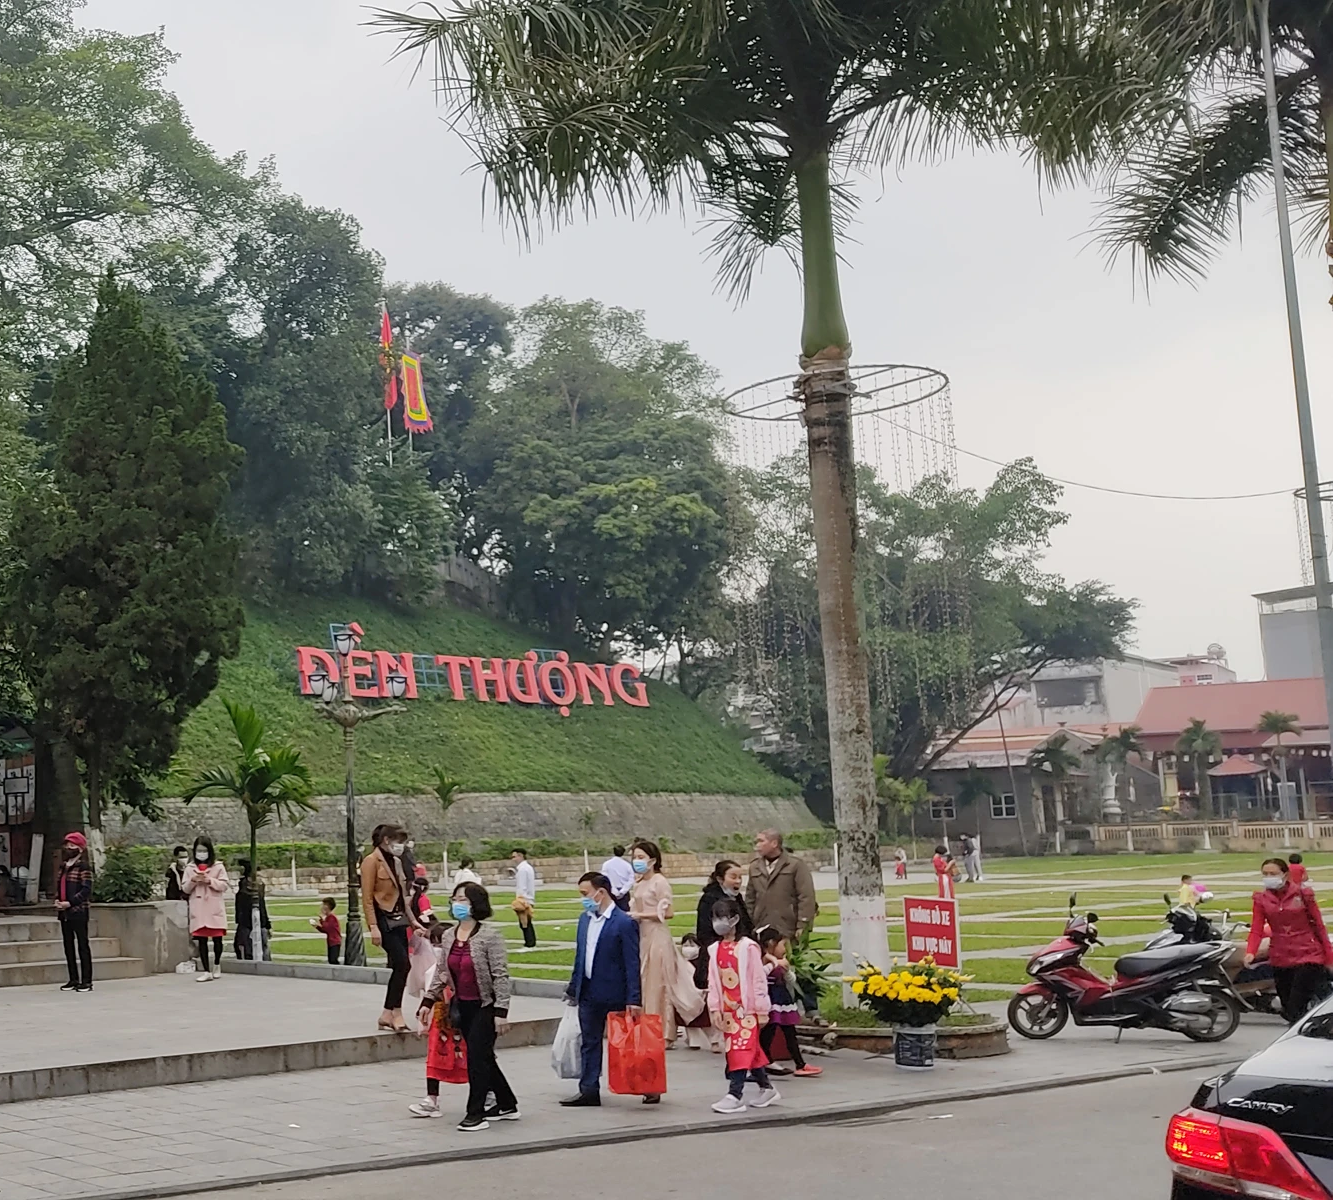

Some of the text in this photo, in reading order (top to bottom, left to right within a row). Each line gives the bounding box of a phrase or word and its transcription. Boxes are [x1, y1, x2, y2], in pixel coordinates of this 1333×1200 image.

[434, 650, 651, 717] THƯỢNG
[909, 905, 931, 925] KHÔNG
[941, 910, 951, 926] XE
[911, 935, 925, 952] KHU
[925, 937, 938, 955] VỰC
[1227, 1097, 1294, 1115] CAMRY
